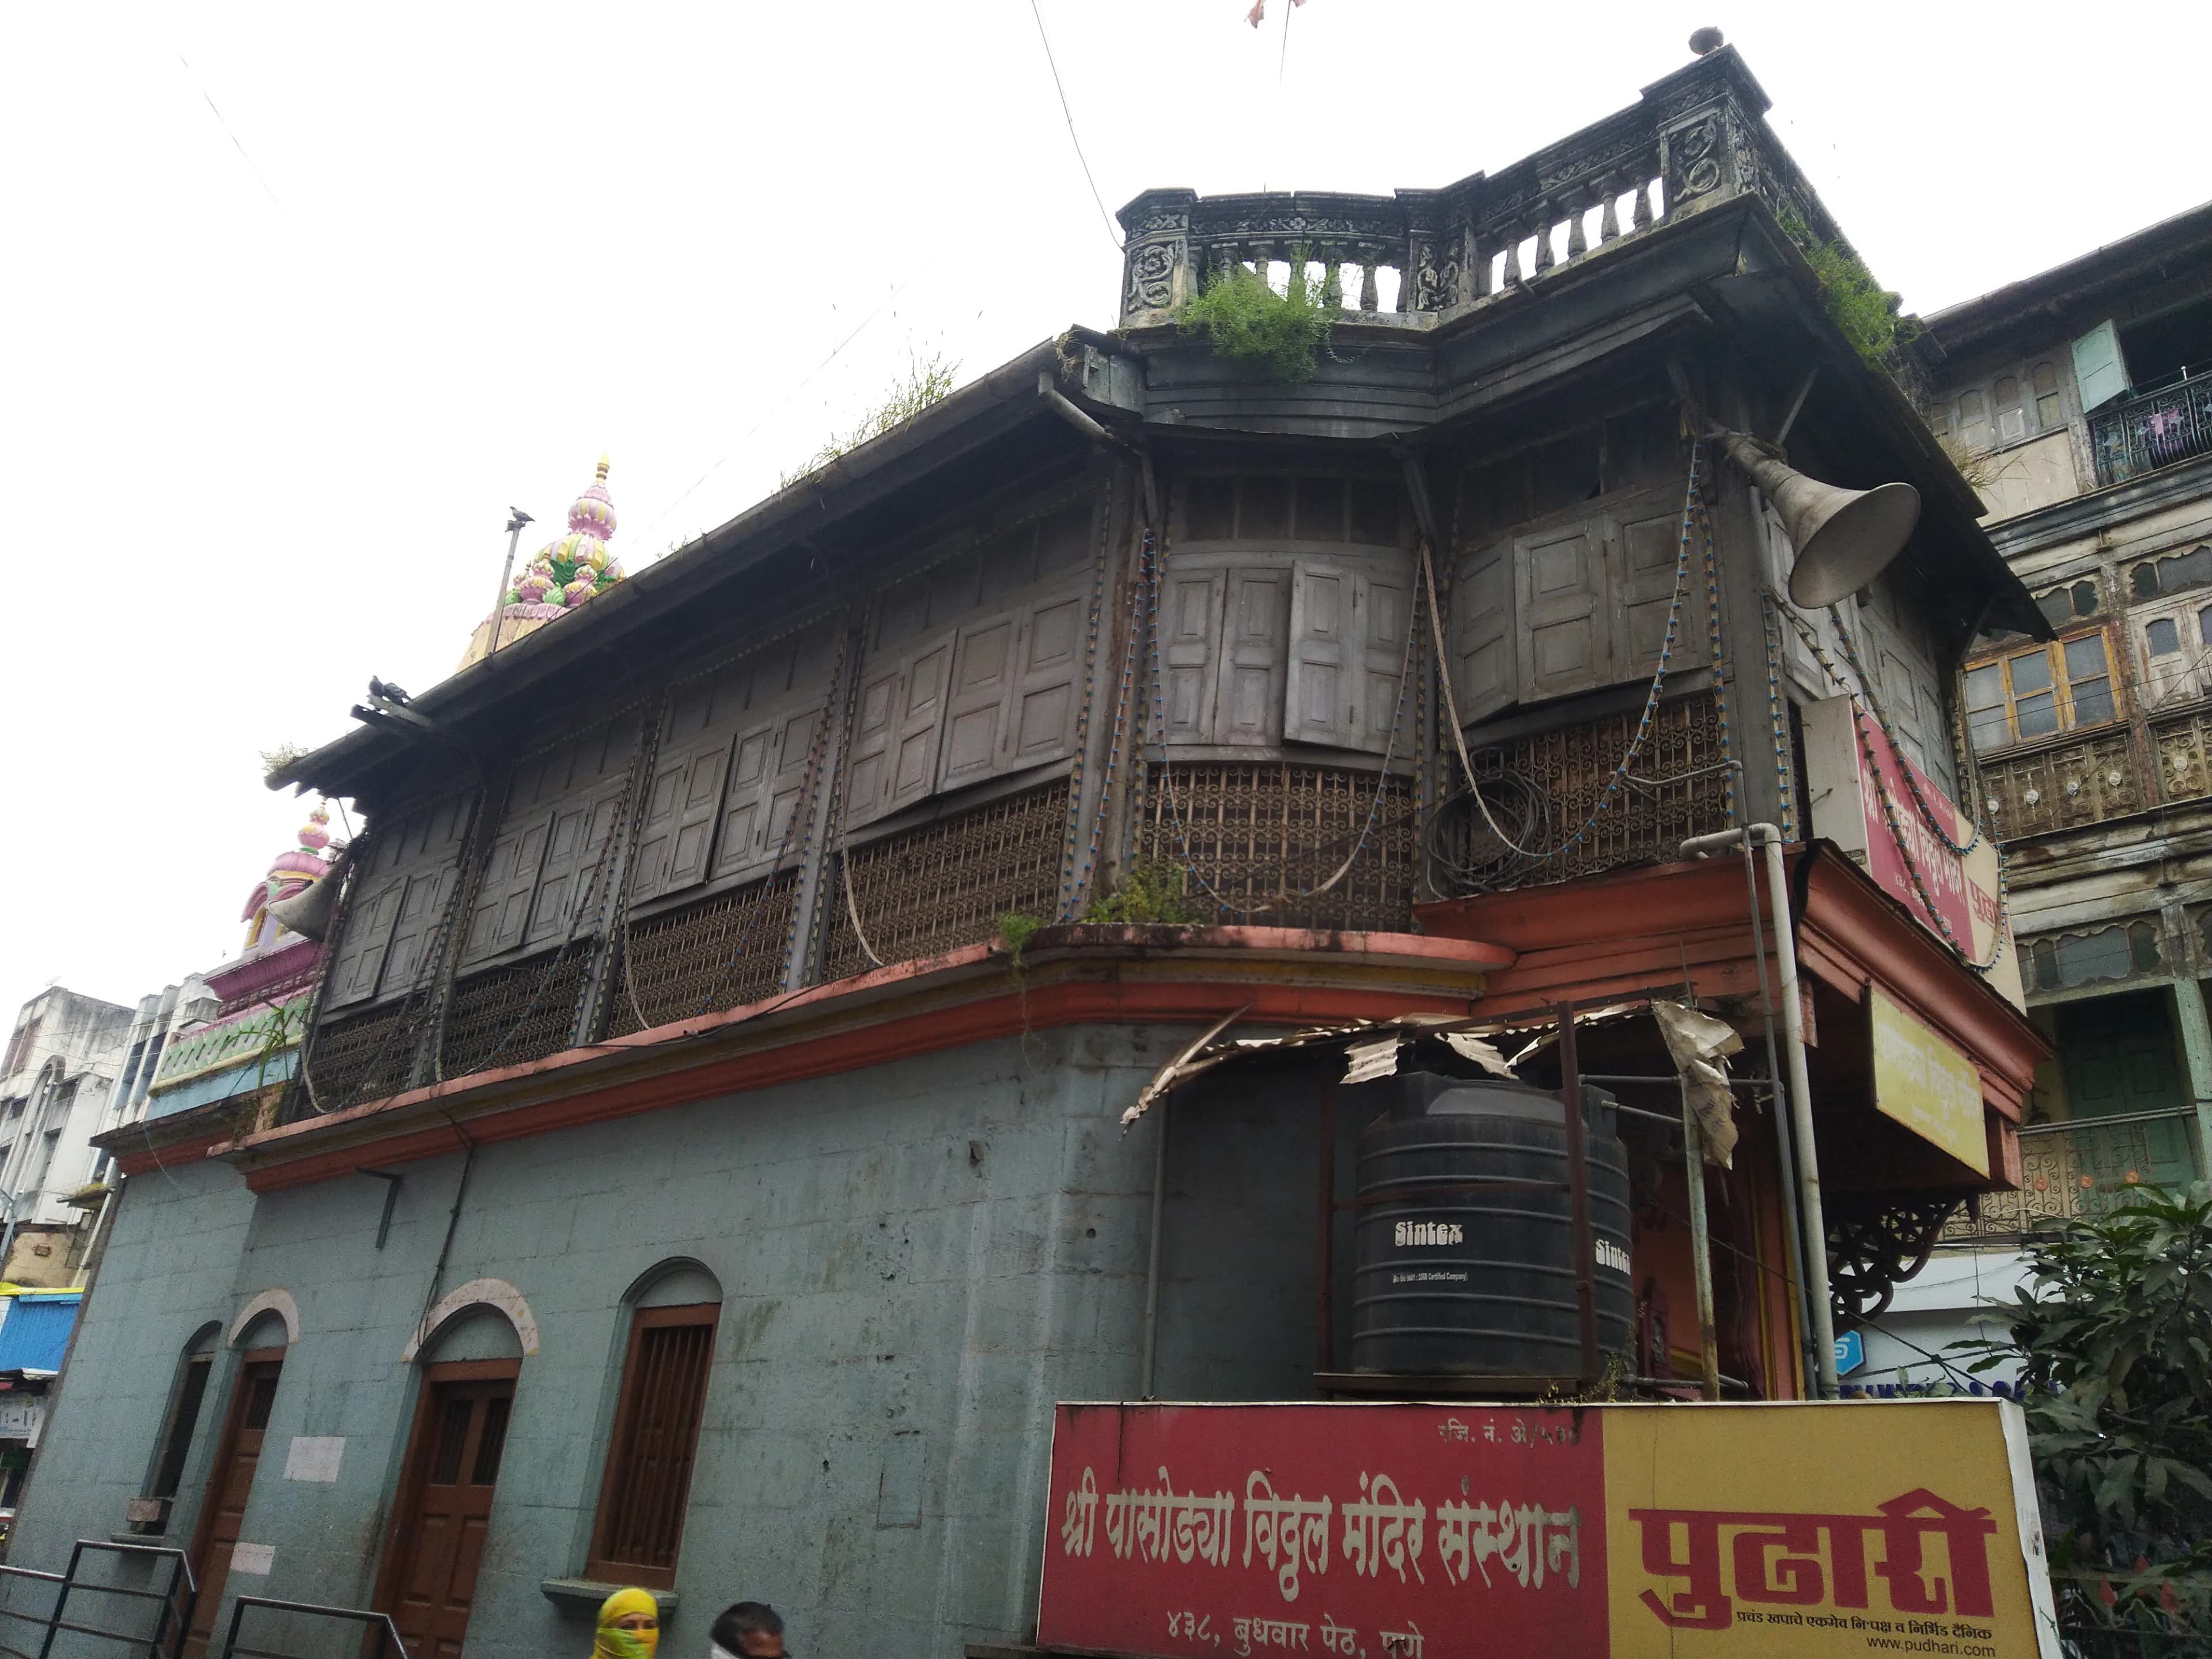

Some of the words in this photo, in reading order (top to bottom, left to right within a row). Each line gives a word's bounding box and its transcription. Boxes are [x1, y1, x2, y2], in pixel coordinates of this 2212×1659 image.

[1395, 1221, 1463, 1247] Sintex
[1061, 1466, 1099, 1558] श्री
[1106, 1465, 1235, 1568] पासोड्या
[1242, 1470, 1332, 1602] विठ्ठल
[1342, 1470, 1426, 1585] मंदिर
[1437, 1474, 1582, 1590] संस्थान
[1628, 1487, 1998, 1631] पुढारी
[1166, 1611, 1220, 1648] ४३८,
[1233, 1618, 1310, 1658] बुधवार
[1320, 1613, 1366, 1659] पेठ,
[1736, 1609, 1763, 1623] प्रचंड
[1766, 1612, 1804, 1626] खपाचे
[1806, 1613, 1848, 1630] एकमेव
[1894, 1621, 1906, 1634] व
[1952, 1623, 1993, 1640] दैनिक
[1866, 1637, 1996, 1657] www.pudhari.com
